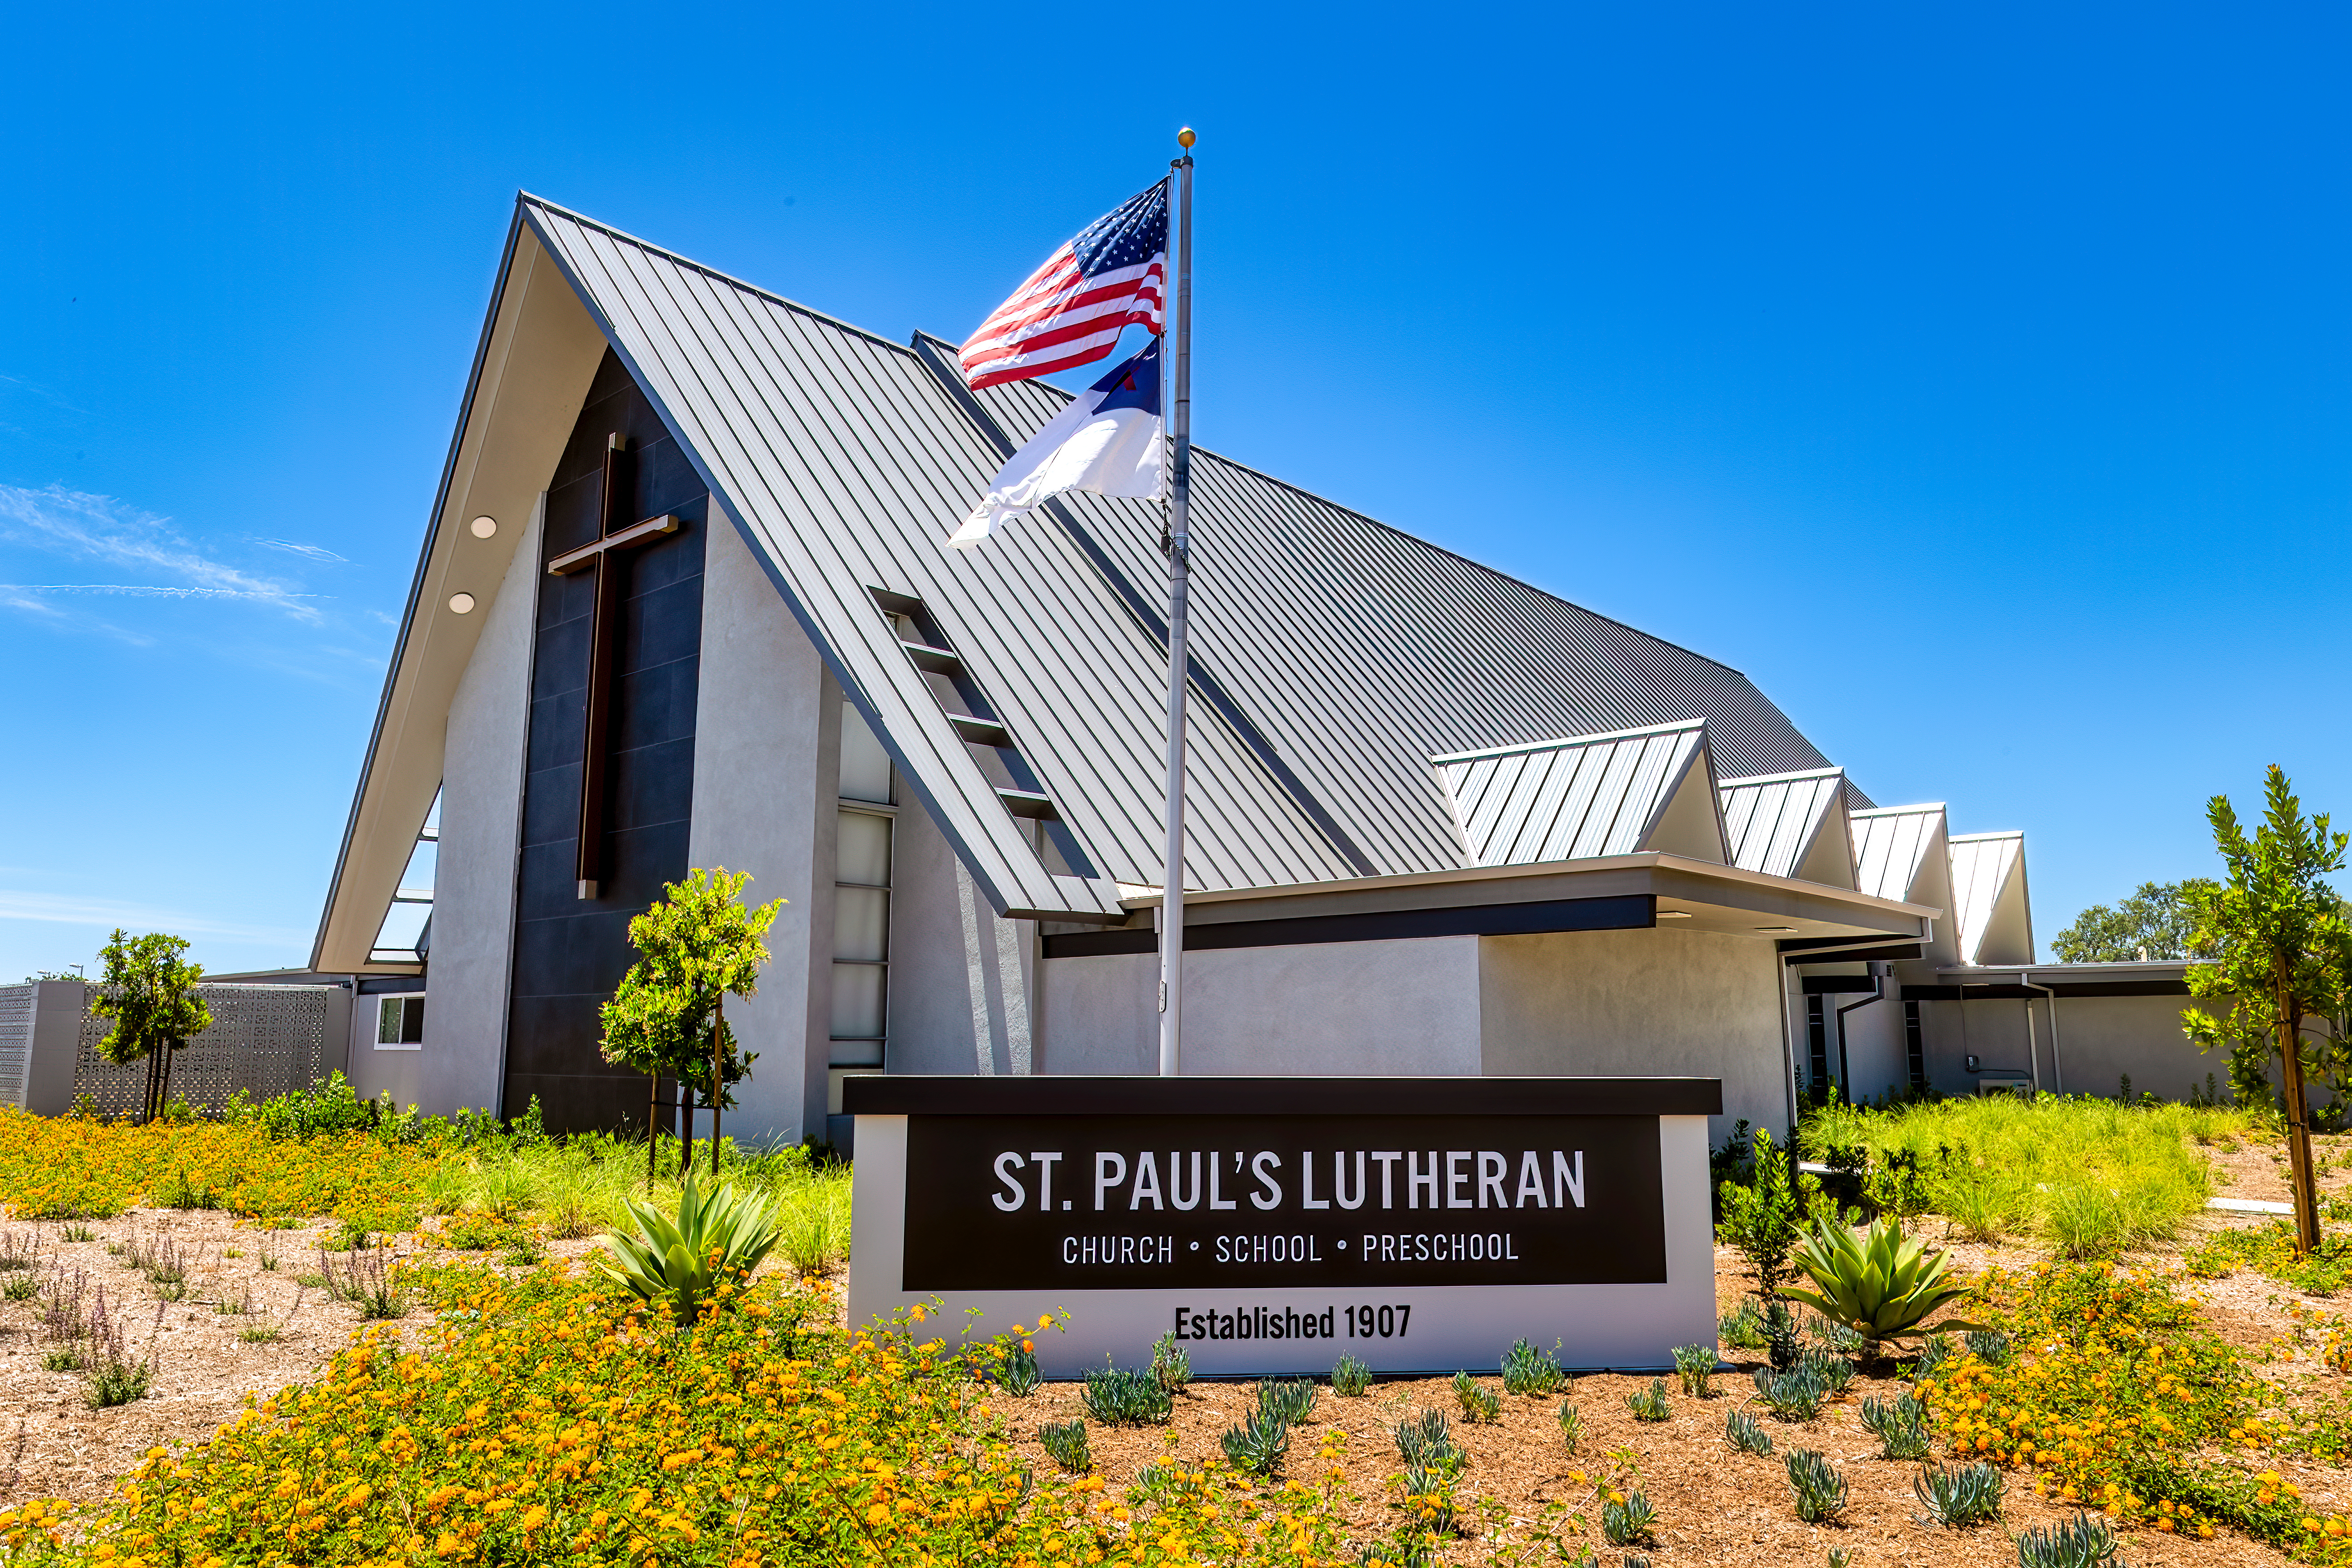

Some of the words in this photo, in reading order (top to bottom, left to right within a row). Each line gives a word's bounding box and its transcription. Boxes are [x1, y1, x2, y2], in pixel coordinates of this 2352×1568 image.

[992, 1151, 1072, 1211] ST.
[1094, 1151, 1283, 1211] PAUL'S
[1302, 1150, 1586, 1210] LUTHERAN
[1063, 1235, 1173, 1264] CHURCH
[1215, 1234, 1322, 1263] SCHOOL
[1363, 1233, 1519, 1262] PRESCHOOL
[1175, 1305, 1335, 1341] Established
[1344, 1304, 1411, 1339] 1907
